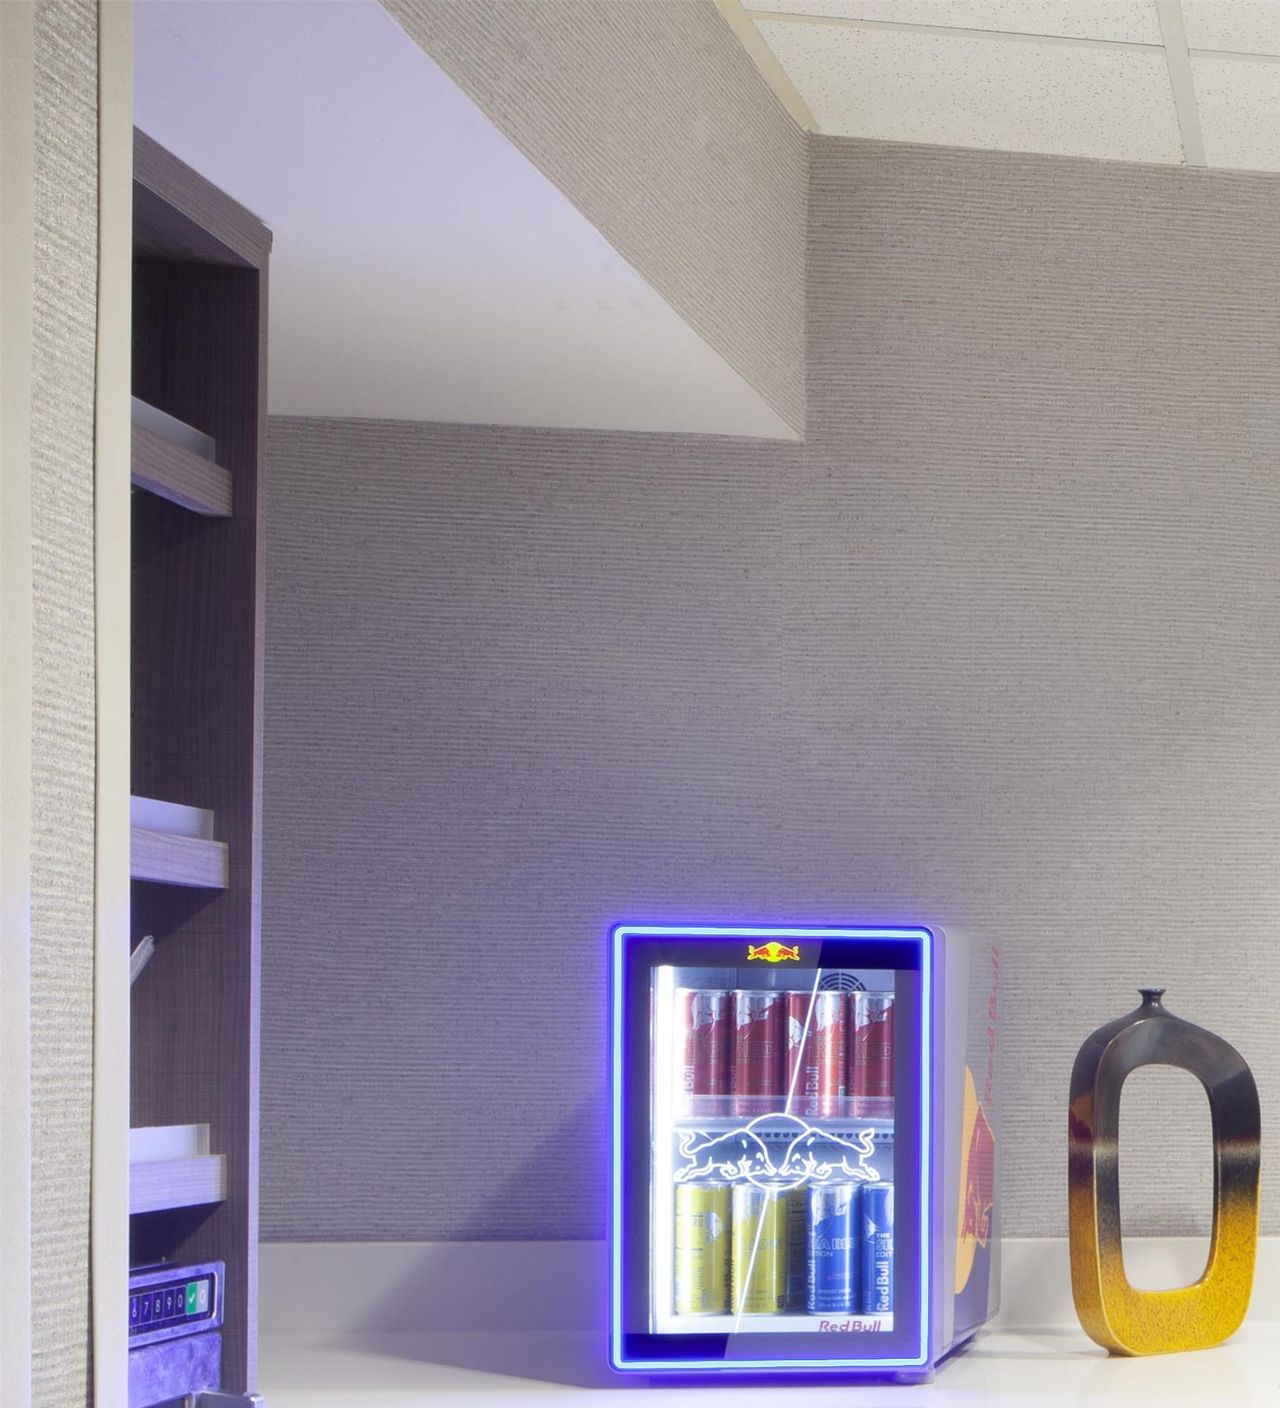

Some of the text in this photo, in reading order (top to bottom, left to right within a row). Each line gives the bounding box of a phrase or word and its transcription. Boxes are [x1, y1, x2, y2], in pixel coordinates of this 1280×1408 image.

[876, 1261, 890, 1312] Red Bull
[819, 1319, 882, 1333] Red Bull
